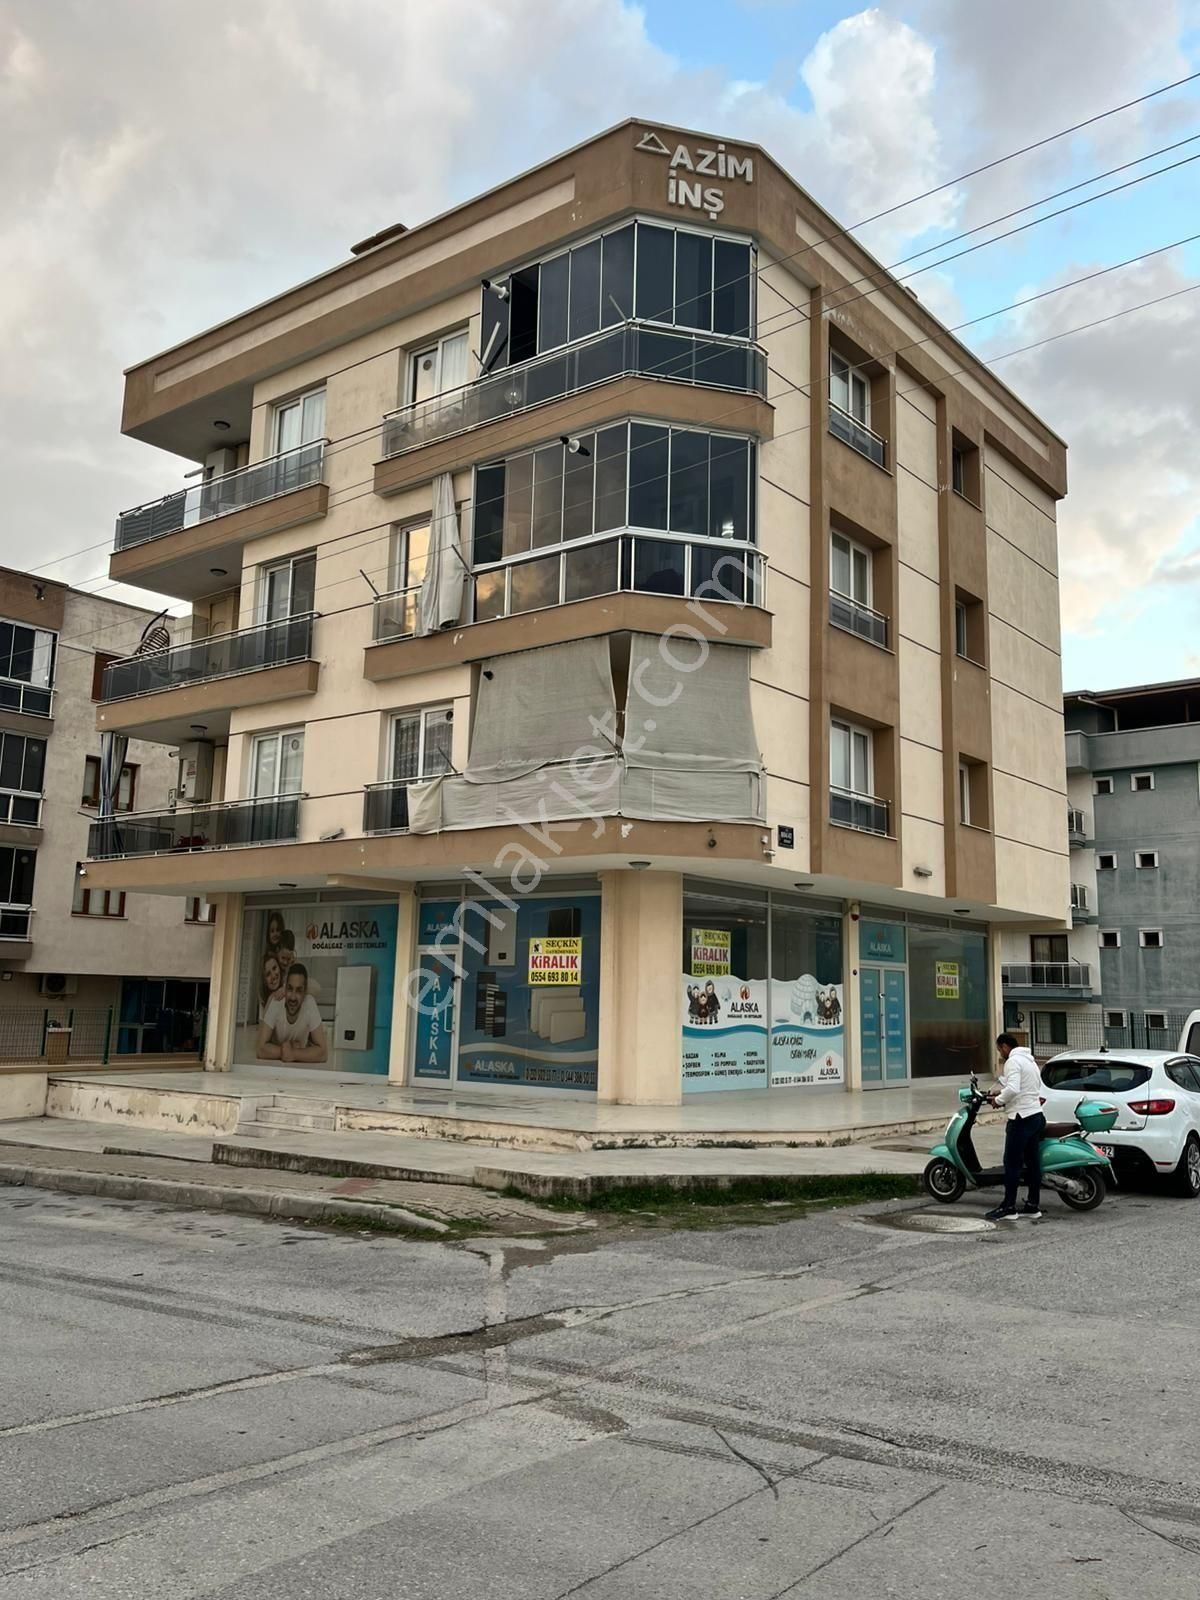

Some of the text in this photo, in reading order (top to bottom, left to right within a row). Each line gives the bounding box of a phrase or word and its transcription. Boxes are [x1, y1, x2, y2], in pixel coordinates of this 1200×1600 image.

[670, 144, 753, 183] AZİM
[668, 169, 725, 220] İNŞ
[320, 921, 380, 939] ALASKA
[545, 939, 578, 949] SEÇKİN
[531, 971, 578, 982] 0554 693 80 14
[730, 1002, 759, 1013] ALASKA
[428, 976, 440, 1065] ALASKA
[475, 1059, 515, 1073] ALASKA
[820, 1068, 839, 1076] ALASKA
